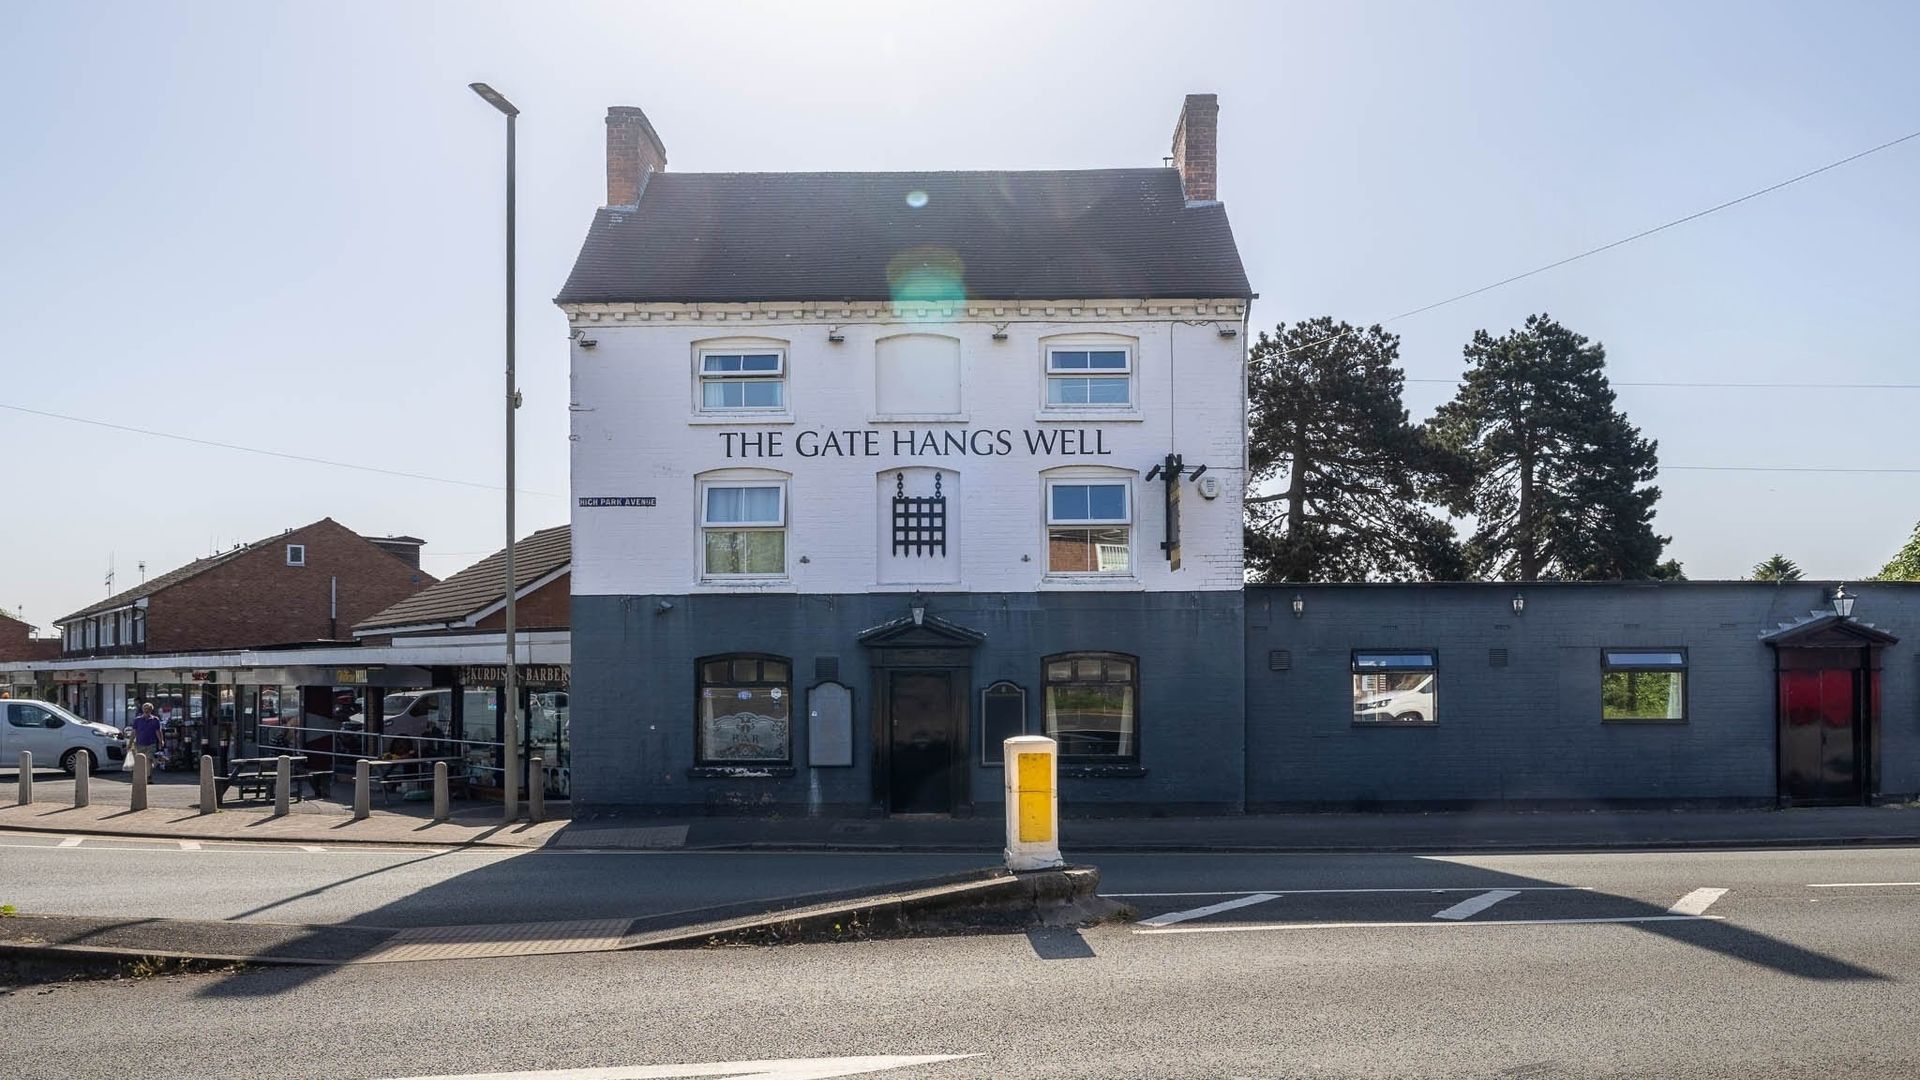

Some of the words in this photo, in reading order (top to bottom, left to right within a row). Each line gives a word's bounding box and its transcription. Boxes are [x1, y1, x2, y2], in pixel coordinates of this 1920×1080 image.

[719, 432, 783, 458] THE
[795, 430, 880, 457] GATE
[892, 429, 1012, 456] HANGS
[1023, 429, 1111, 455] WELL
[579, 498, 599, 506] HIGH
[600, 498, 622, 506] PARK
[624, 498, 656, 506] AVENUE
[470, 667, 508, 681] KURDIS
[732, 733, 760, 744] BAR
